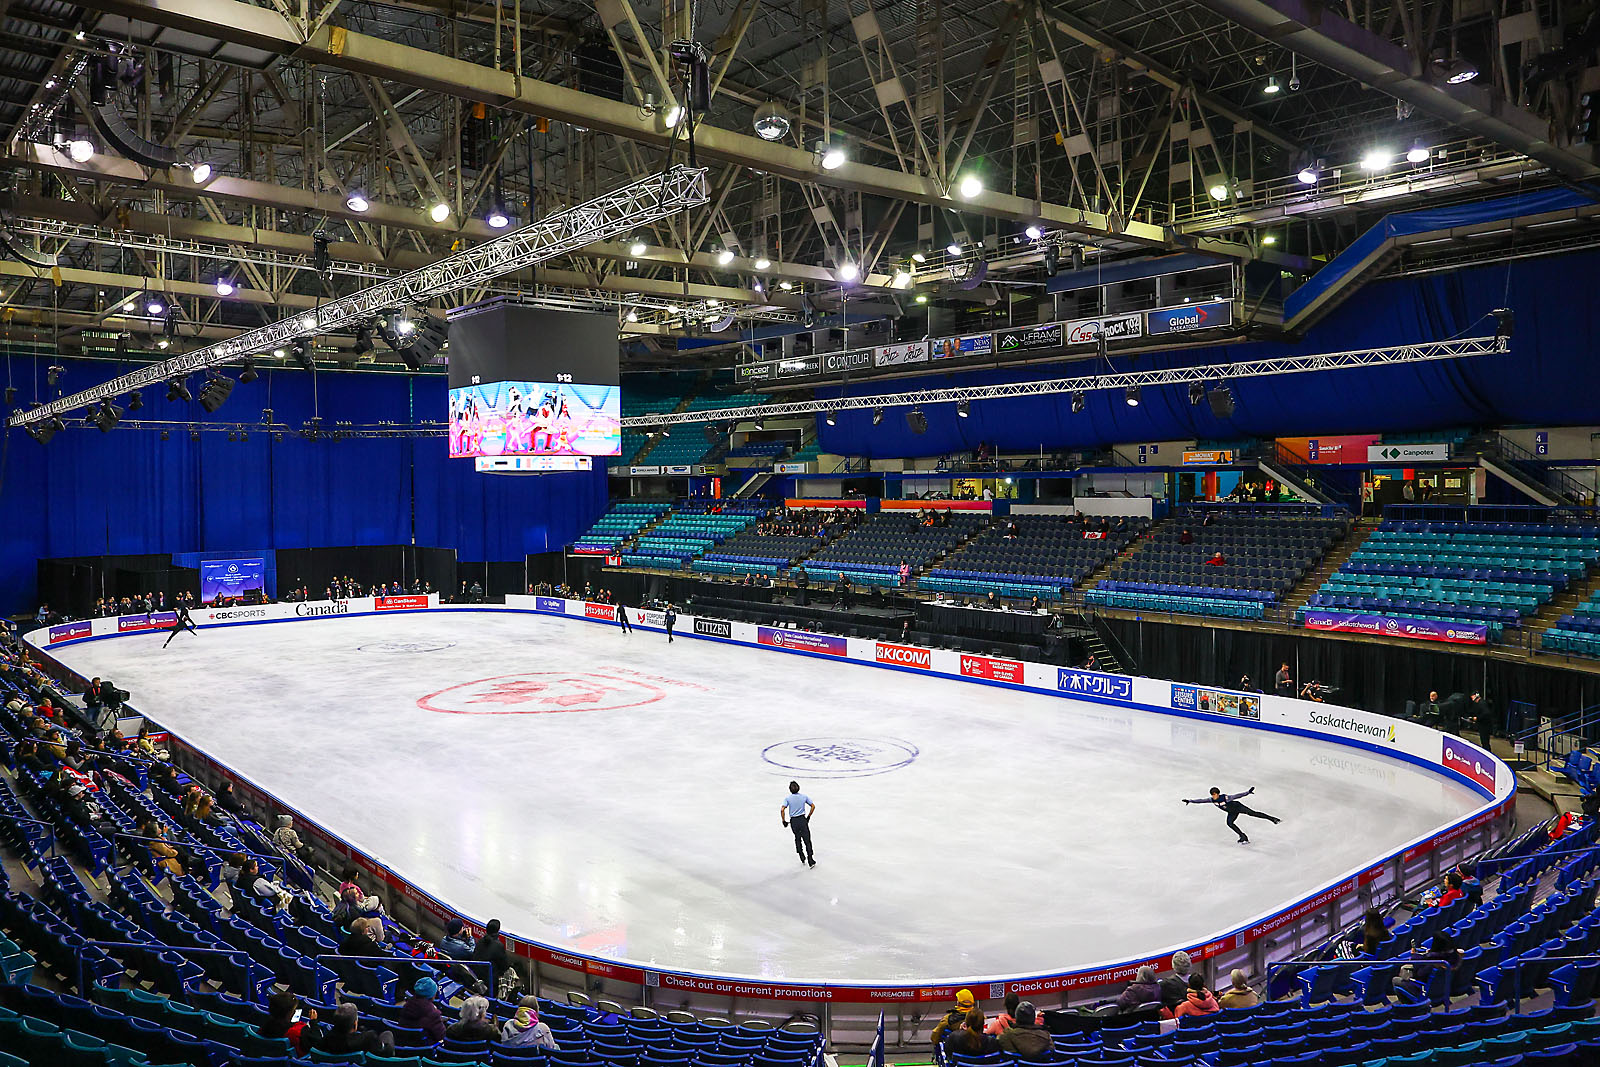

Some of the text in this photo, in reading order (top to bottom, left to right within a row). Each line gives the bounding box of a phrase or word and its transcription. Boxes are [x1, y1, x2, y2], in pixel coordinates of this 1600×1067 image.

[1169, 314, 1199, 327] Global
[1105, 321, 1125, 337] ROCK
[1125, 318, 1139, 331] 102
[1169, 323, 1199, 332] SASKATOON
[974, 338, 990, 347] NEWS
[1023, 337, 1057, 346] CONSTRUCTION
[828, 353, 870, 368] CONTOUR
[1403, 449, 1434, 457] Canpotex
[296, 600, 348, 616] Canada
[646, 612, 665, 620] CORPORAT
[696, 622, 729, 635] CITIZEN
[1309, 617, 1375, 629] Canada Saskatchewan
[884, 648, 931, 666] KICONA
[1070, 676, 1130, 697] 木下グループ
[1173, 696, 1195, 705] CENTRES
[1174, 691, 1194, 699] LEISURE
[1309, 711, 1386, 738] Saskatchewan
[1252, 927, 1263, 937] The
[1262, 914, 1291, 934] Smartphone
[1291, 908, 1300, 921] you
[1300, 903, 1311, 914] want
[1315, 896, 1328, 907] stock
[665, 976, 832, 1000] Check out our current promotions
[1010, 981, 1042, 994] Check
[1044, 979, 1060, 990] out
[1061, 978, 1077, 988] our
[1079, 972, 1112, 986] current
